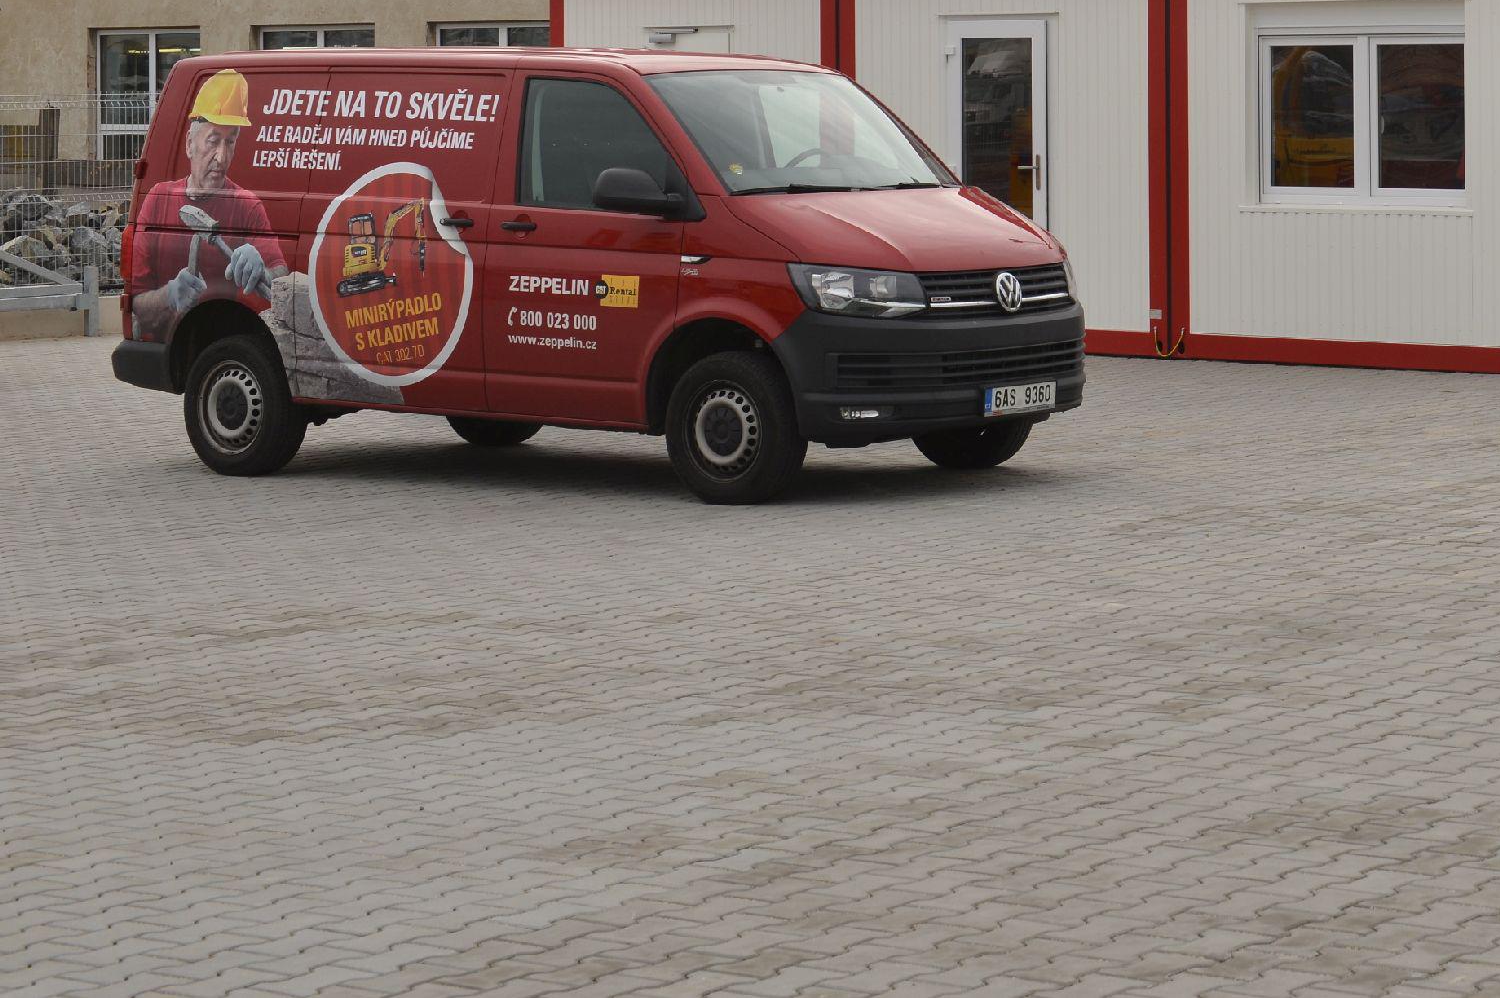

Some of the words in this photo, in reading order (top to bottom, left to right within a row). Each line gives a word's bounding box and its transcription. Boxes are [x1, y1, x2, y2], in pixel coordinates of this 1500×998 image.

[262, 88, 332, 117] JDETE
[333, 90, 367, 118] NA
[373, 90, 403, 119] TO
[405, 88, 500, 123] SKVĚLE!
[255, 125, 281, 143] ALE
[283, 124, 333, 145] RADĚJI
[334, 125, 367, 146] VÁM
[368, 128, 407, 148] HNED
[409, 126, 475, 150] PŮJČÍME
[252, 148, 291, 168] LEPŠÍ
[291, 149, 343, 171] ŘEŠENÍ.
[508, 275, 590, 296] ZEPPELIN
[608, 286, 638, 296] Rental
[344, 292, 442, 330] MINIRÝPADLO
[520, 310, 543, 328] 800
[546, 312, 571, 330] 023
[573, 314, 598, 331] 000
[355, 332, 365, 351] S
[366, 317, 440, 348] KLADIVEM
[507, 334, 598, 351] www.zeppelin.cz
